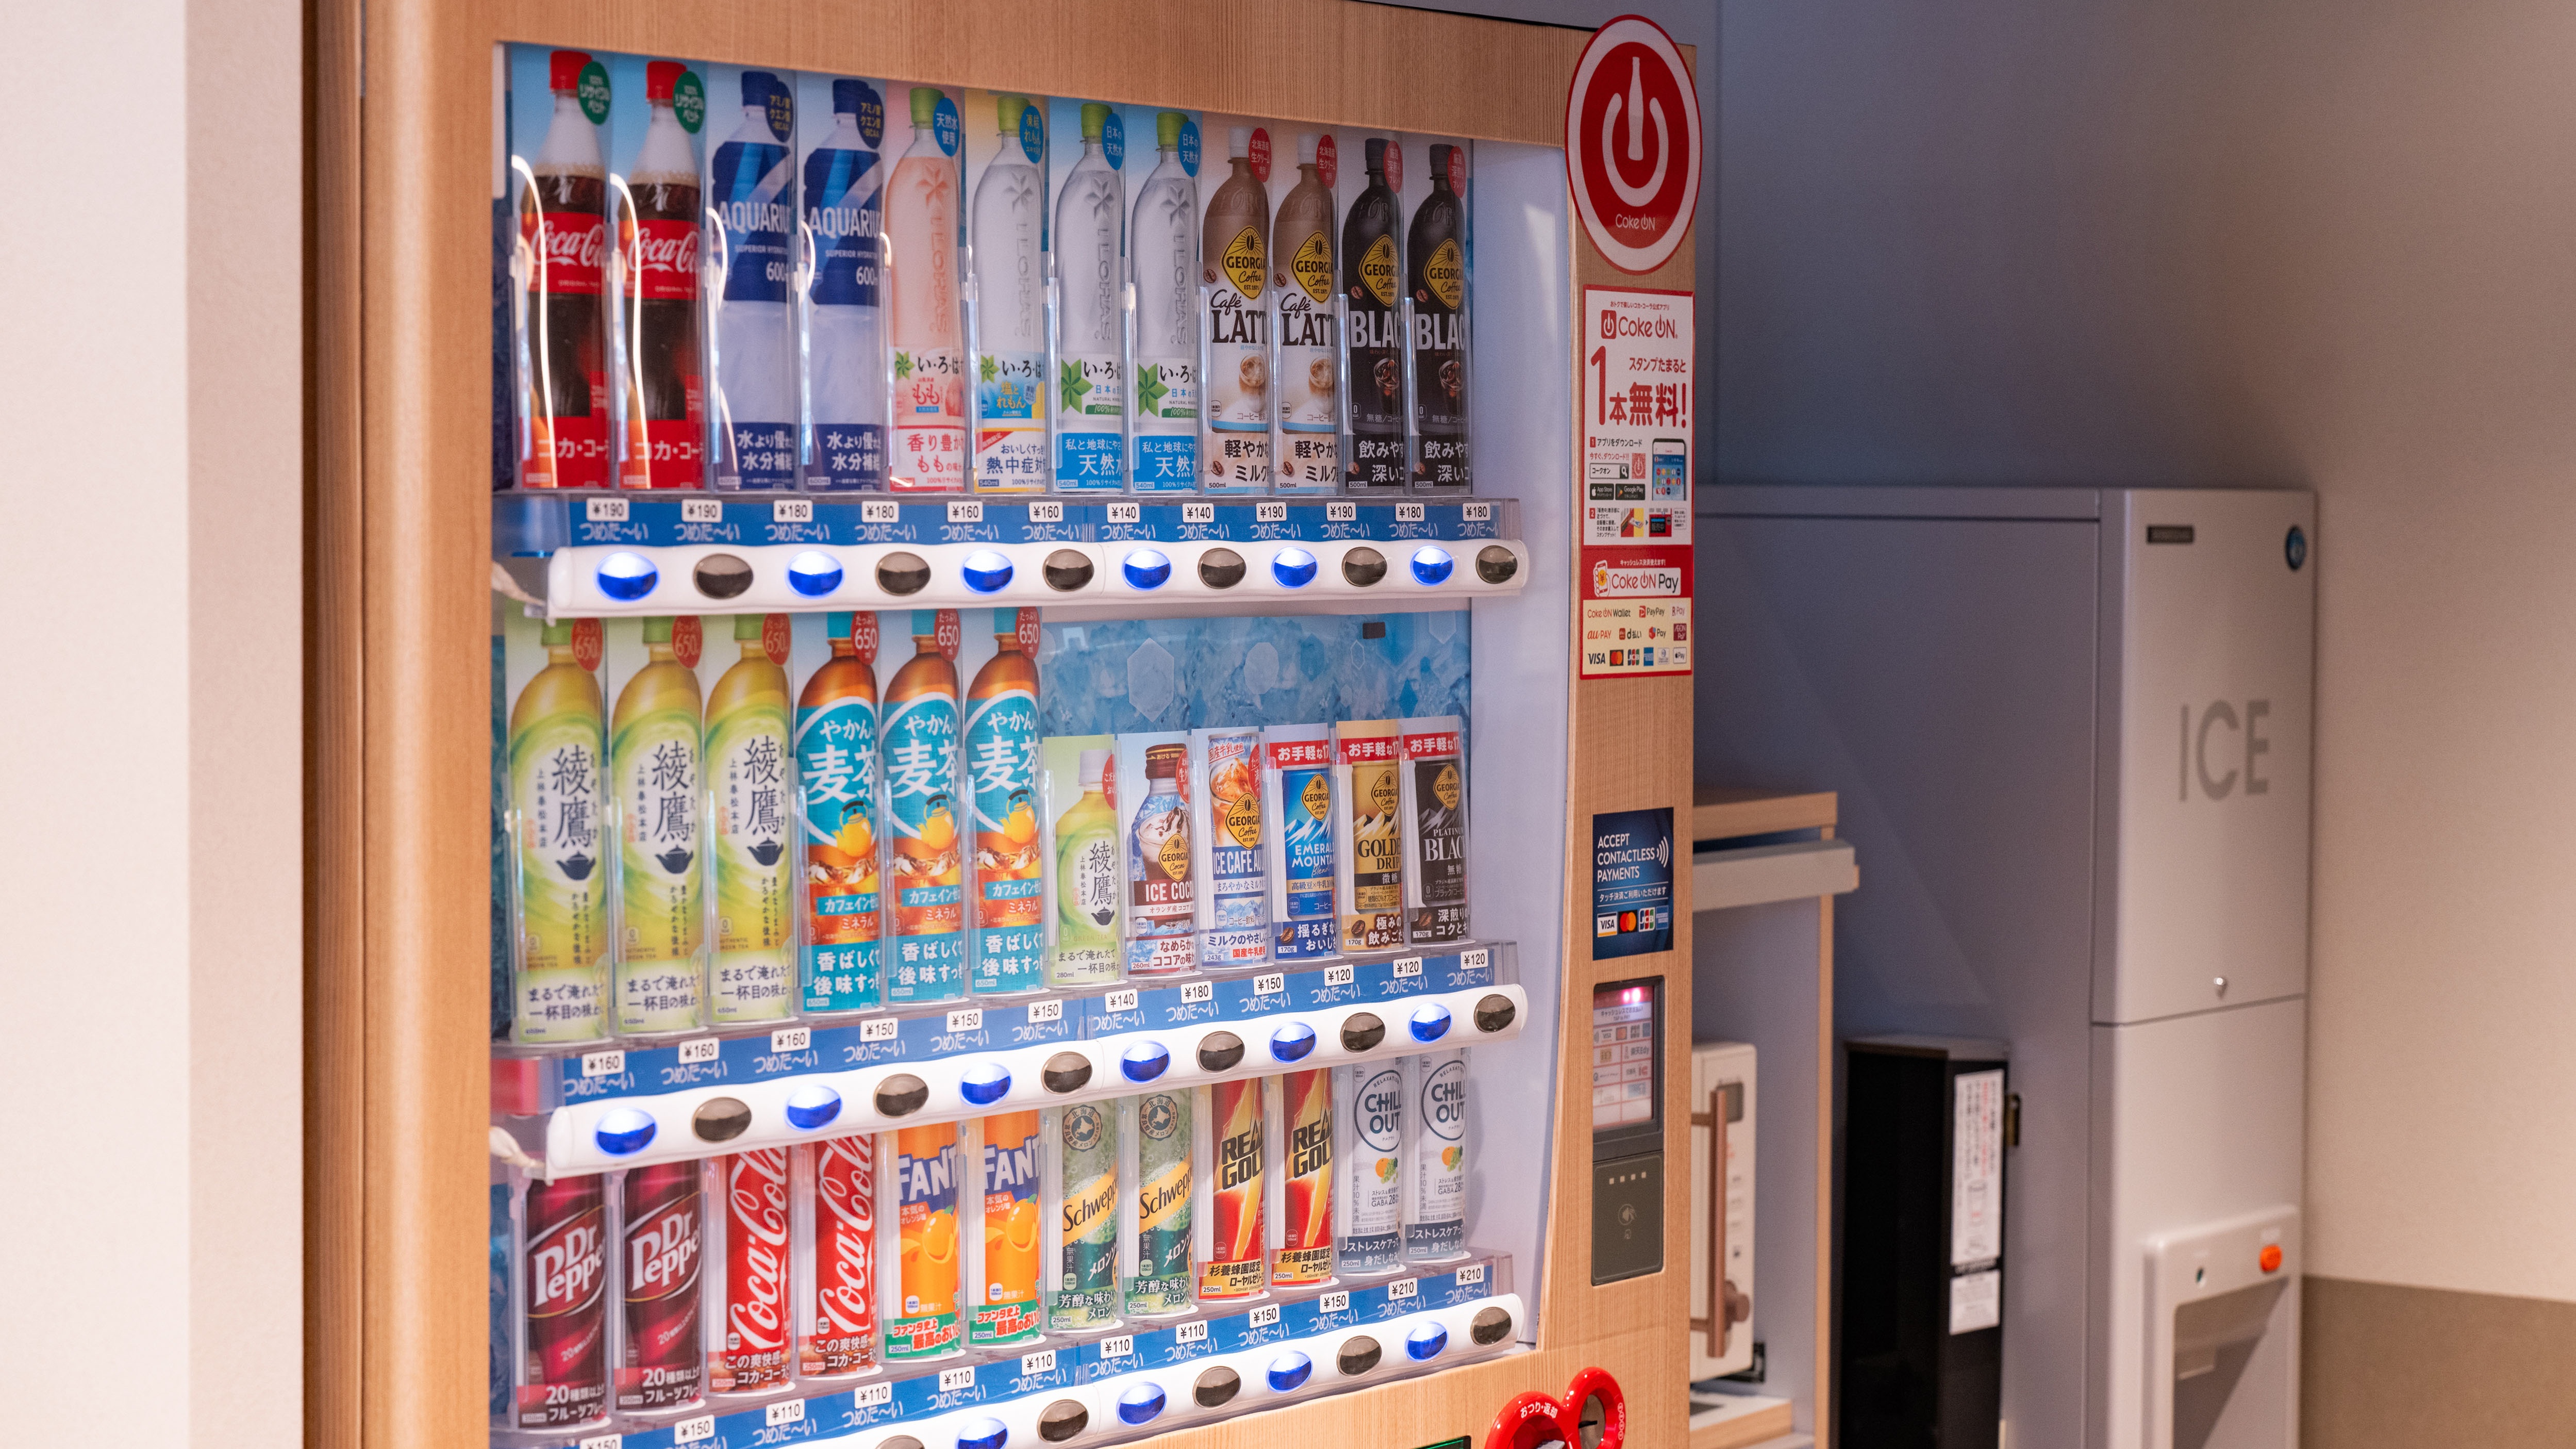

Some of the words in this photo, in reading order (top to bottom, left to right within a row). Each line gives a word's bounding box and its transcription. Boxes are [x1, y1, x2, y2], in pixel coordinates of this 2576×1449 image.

[936, 113, 958, 127] 天然水
[942, 130, 956, 145] 使用
[1106, 126, 1122, 139] 日本の
[1183, 134, 1200, 147] 日本の
[1107, 143, 1123, 157] 天然水
[1226, 256, 1266, 270] GEORGIA
[1295, 260, 1334, 275] GEORGIA
[1239, 271, 1261, 283] Coffee
[1308, 275, 1329, 287] Coffee
[1210, 289, 1242, 316] Café
[1281, 293, 1311, 319] Café
[1629, 357, 1686, 373] スタンプたまると
[996, 397, 1026, 409] れもん
[1598, 437, 1642, 447] アプリをダウンロード
[593, 503, 624, 517] ¥190
[687, 504, 717, 518] ¥190
[778, 504, 807, 518] ¥180
[867, 505, 894, 519] ¥180
[953, 505, 979, 519] ¥160
[1034, 505, 1059, 519] ¥160
[1111, 506, 1136, 520] ¥140
[1187, 507, 1211, 520] ¥140
[1260, 505, 1284, 519] ¥190
[1330, 505, 1353, 518] ¥190
[1399, 506, 1421, 519] ¥180
[1466, 506, 1487, 519] ¥180
[1611, 573, 1638, 589] Coke
[1658, 573, 1679, 593] Pay
[1587, 609, 1602, 618] Coke
[1613, 608, 1631, 617] Wallet
[1647, 607, 1665, 616] PayPay
[855, 629, 877, 649] 650
[938, 628, 959, 647] 650
[1019, 625, 1039, 645] 650
[1657, 628, 1666, 637] Pay
[765, 635, 787, 661] 650
[1588, 653, 1606, 665] VISA
[2179, 699, 2271, 803] ICE
[652, 740, 690, 843] 綾鷹
[743, 735, 779, 835] 綾鷹
[552, 744, 592, 849] 綾鷹
[1304, 793, 1329, 802] GEORGIA
[1373, 788, 1398, 797] GEORGIA
[1311, 802, 1326, 811] Coffee
[1381, 798, 1395, 806] Coffee
[1229, 816, 1260, 826] GEORGIA
[1238, 827, 1257, 837] Coffee
[1598, 833, 1630, 849] ACCEPT
[1161, 852, 1188, 862] GEORGIA
[1213, 852, 1226, 875] ICE
[1227, 850, 1252, 874] CAFE
[1598, 847, 1655, 865] CONTACTLESS
[1089, 840, 1112, 906] 綾鷹
[1448, 864, 1461, 875] 無糖
[1598, 865, 1639, 883] PAYMENTS
[1382, 872, 1398, 884] 微糖
[1145, 883, 1167, 902] ICE
[1599, 886, 1667, 902] タッチ決済ご利用いただけます
[925, 908, 956, 921] ミネラル
[1008, 901, 1037, 914] ミネラル
[1600, 919, 1615, 930] VISA
[1464, 953, 1485, 966] ¥120
[1397, 960, 1419, 974] ¥120
[1328, 968, 1351, 981] ¥120
[1258, 977, 1281, 991] ¥150
[1185, 985, 1209, 999] ¥180
[1110, 993, 1134, 1008] ¥140
[1033, 1003, 1059, 1018] ¥150
[952, 1013, 979, 1027] ¥150
[866, 1023, 894, 1037] ¥150
[776, 1032, 806, 1047] ¥160
[685, 1044, 714, 1059] ¥160
[588, 1055, 619, 1071] ¥160
[1431, 1081, 1466, 1102] CHILL
[1365, 1089, 1402, 1113] CHILL
[1436, 1102, 1465, 1123] OUT
[1370, 1112, 1400, 1134] OUT
[986, 1195, 1008, 1206] 本気の
[660, 1210, 692, 1247] Dr
[565, 1223, 598, 1260] Dr
[1066, 1247, 1074, 1272] 無果汁
[1281, 1248, 1331, 1263] 杉養蜂園認定
[1209, 1261, 1261, 1277] 杉養蜂園認定
[1459, 1269, 1481, 1281] ¥210
[1392, 1282, 1414, 1295] ¥210
[1324, 1295, 1347, 1308] ¥150
[977, 1305, 1020, 1324] ファンタ史上
[1253, 1308, 1277, 1322] ¥150
[893, 1318, 938, 1337] ファンタ史上
[1181, 1325, 1204, 1337] ¥110
[1105, 1339, 1130, 1353] ¥110
[1027, 1355, 1053, 1368] ¥110
[944, 1371, 971, 1385] ¥110
[860, 1387, 888, 1403] ¥110
[772, 1405, 801, 1420] ¥110
[1520, 1401, 1558, 1419] おつり・返却
[681, 1422, 710, 1437] ¥150
